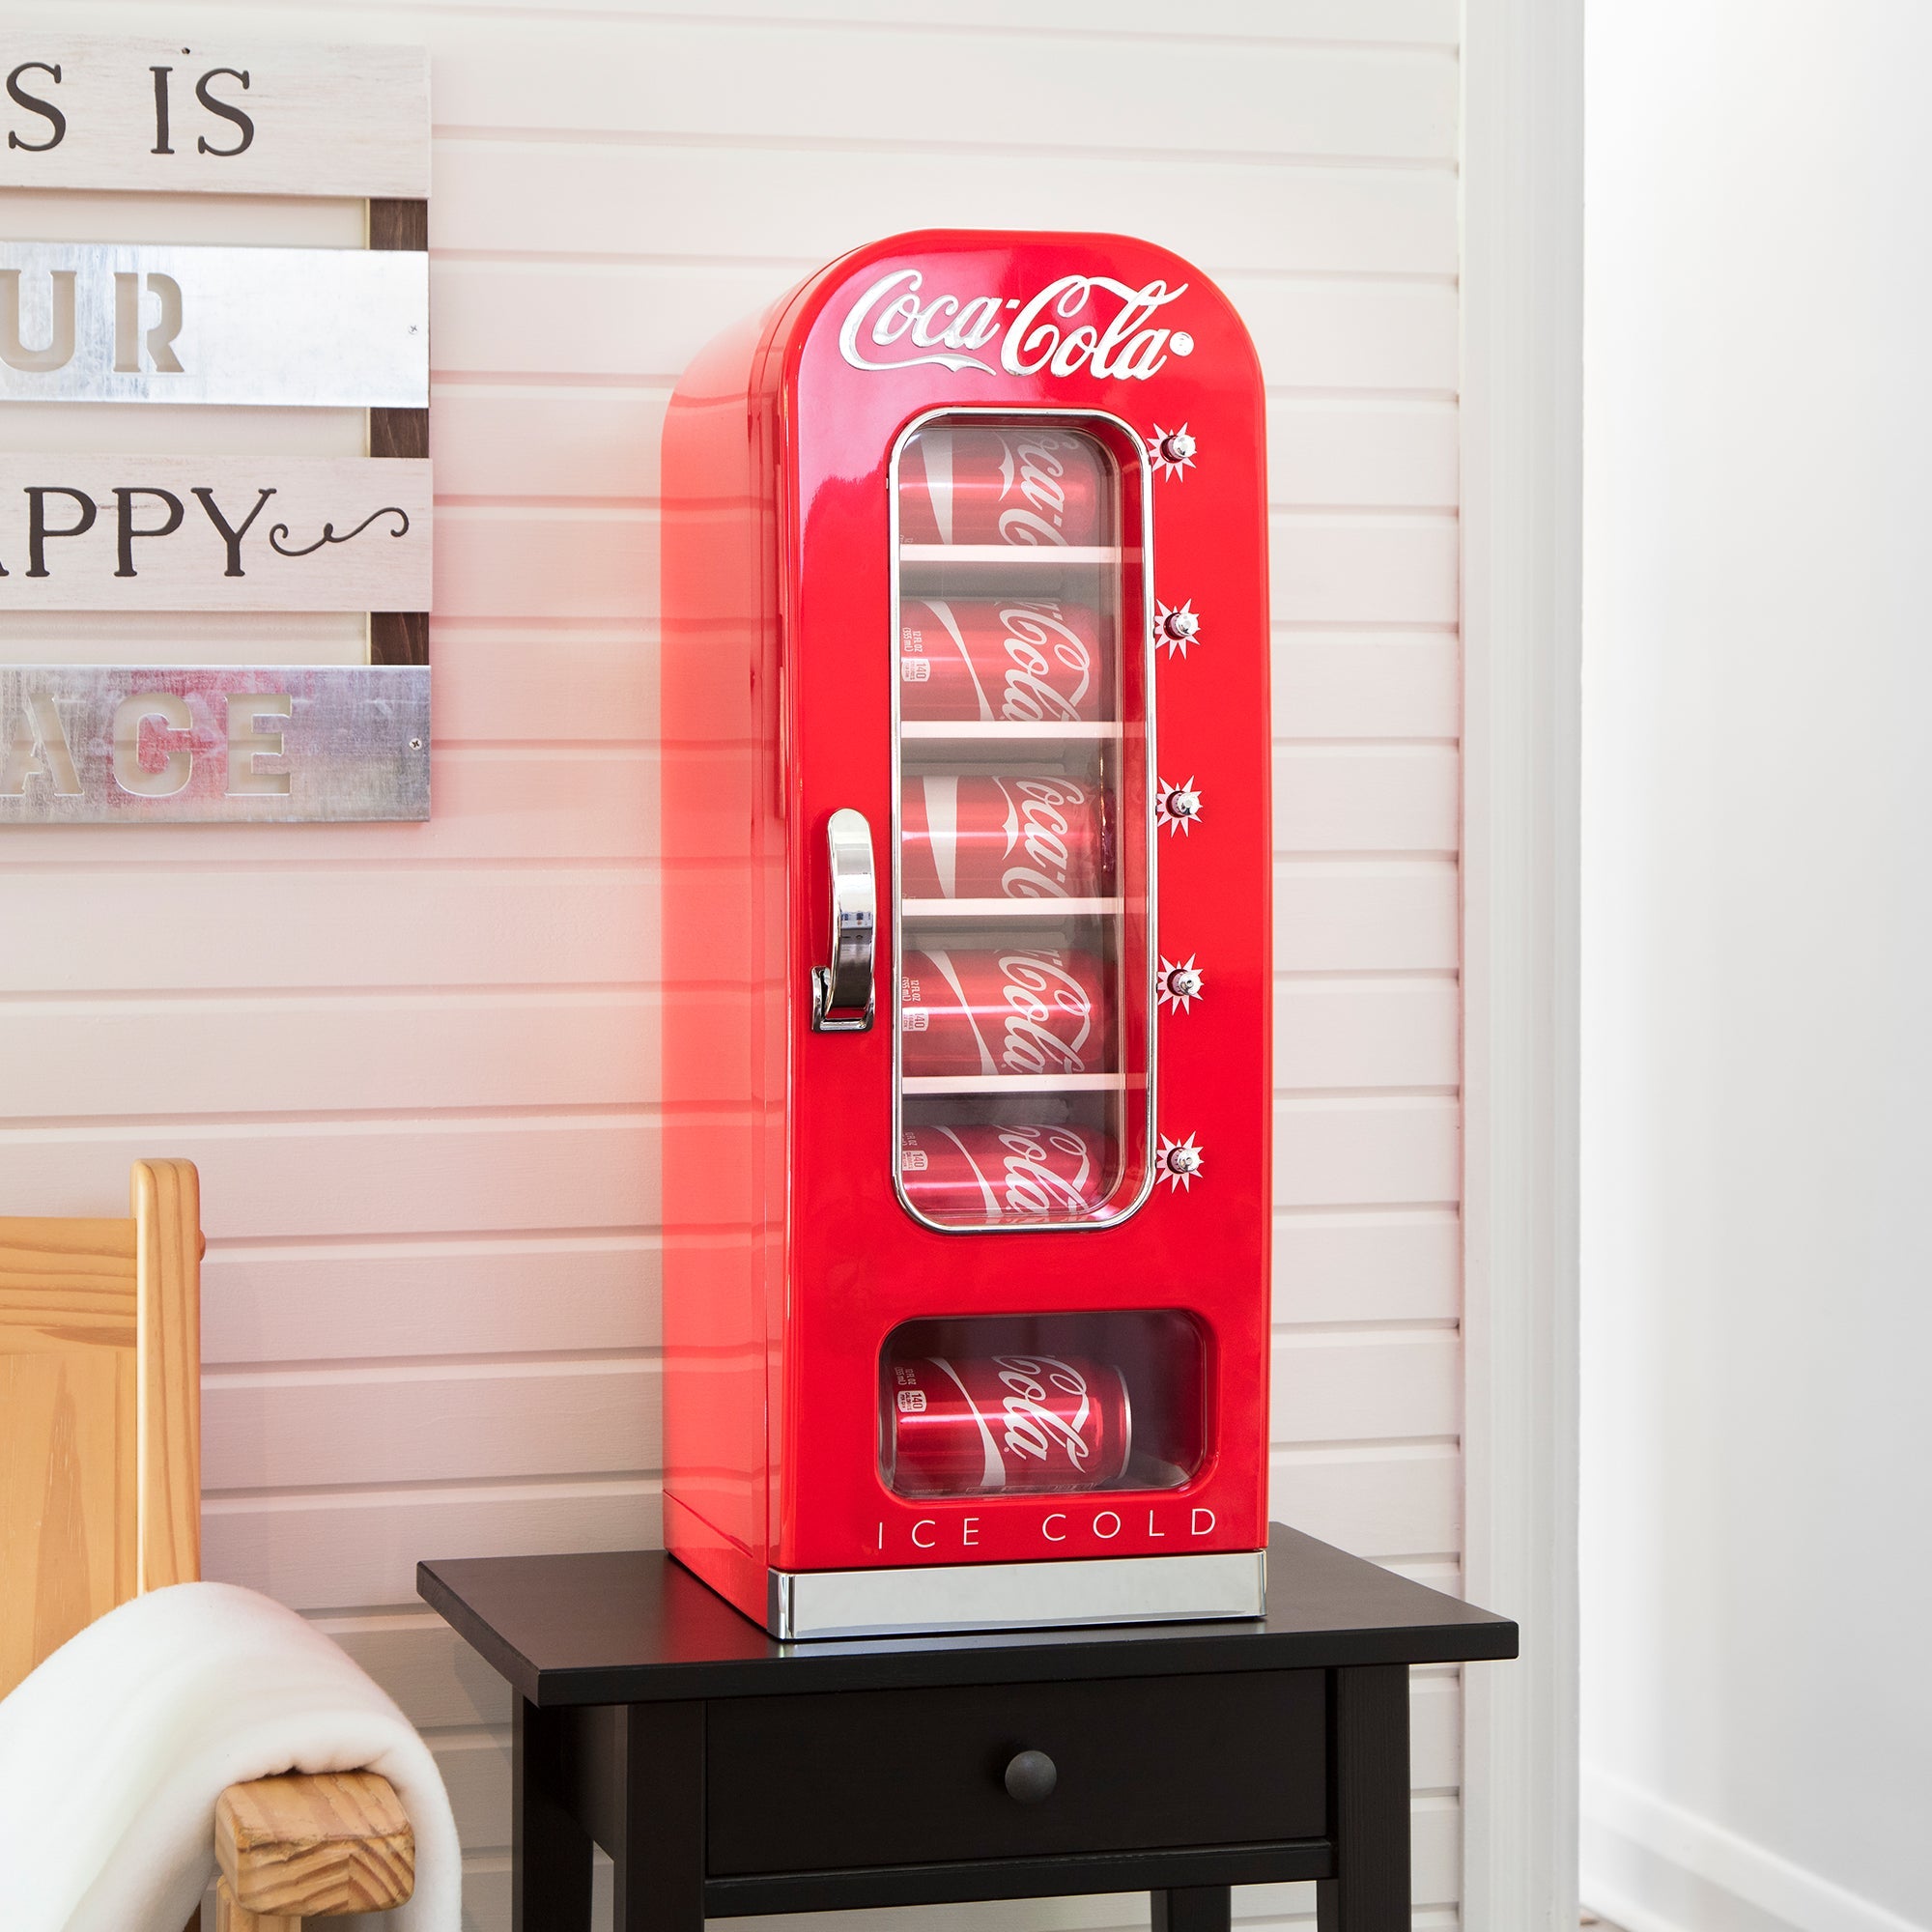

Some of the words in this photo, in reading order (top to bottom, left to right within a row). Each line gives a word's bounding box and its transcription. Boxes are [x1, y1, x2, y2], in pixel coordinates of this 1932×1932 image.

[149, 67, 255, 156] IS
[838, 269, 1189, 381] Coca-Cola
[0, 487, 277, 577] PPY
[916, 663, 927, 678] 140
[0, 693, 292, 798] ACE
[913, 1152, 924, 1168] 140
[912, 1392, 923, 1409] 140
[991, 1355, 1090, 1473] Cola
[878, 1517, 980, 1549] ICE
[1042, 1508, 1216, 1542] COLD
